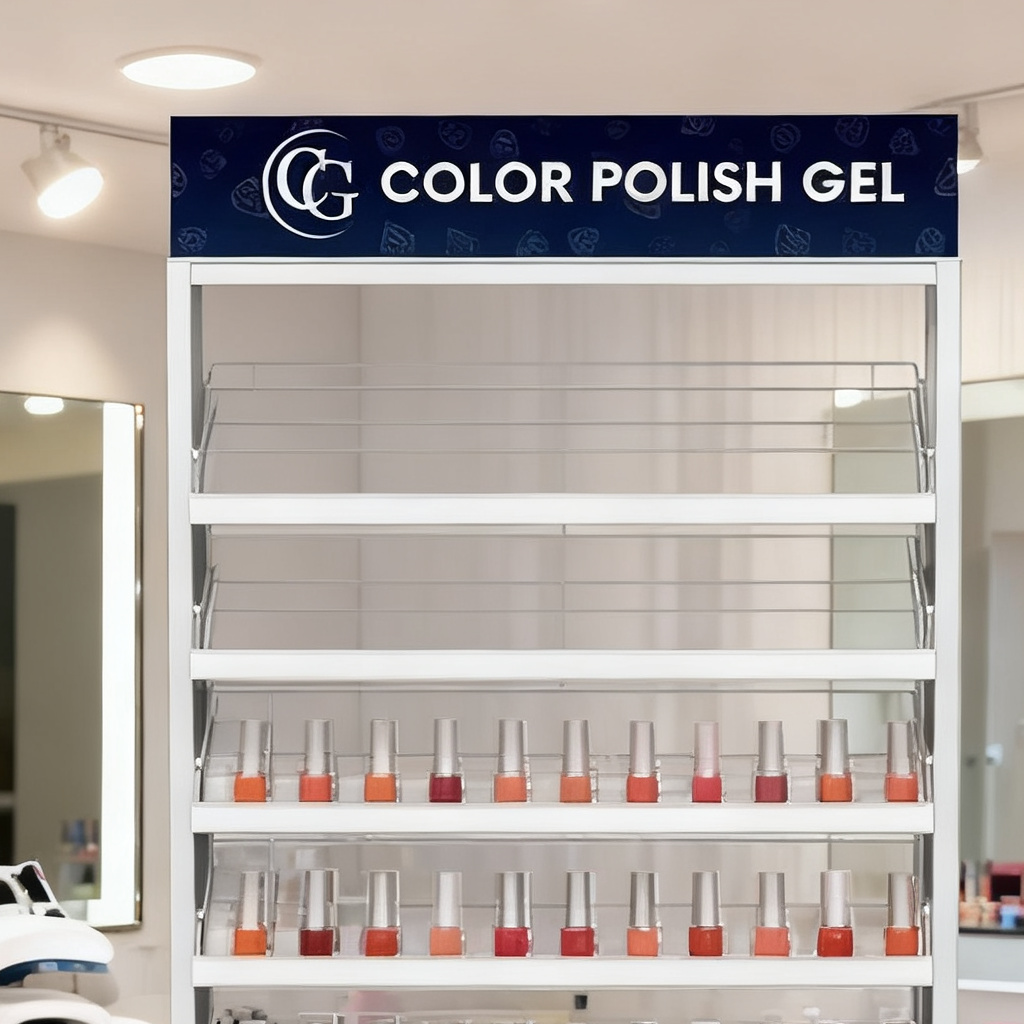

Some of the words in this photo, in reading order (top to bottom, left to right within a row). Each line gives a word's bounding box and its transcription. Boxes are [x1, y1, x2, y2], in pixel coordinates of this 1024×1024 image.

[380, 161, 573, 203] COLOR
[592, 161, 782, 203] POLISH
[802, 161, 905, 203] GEL
